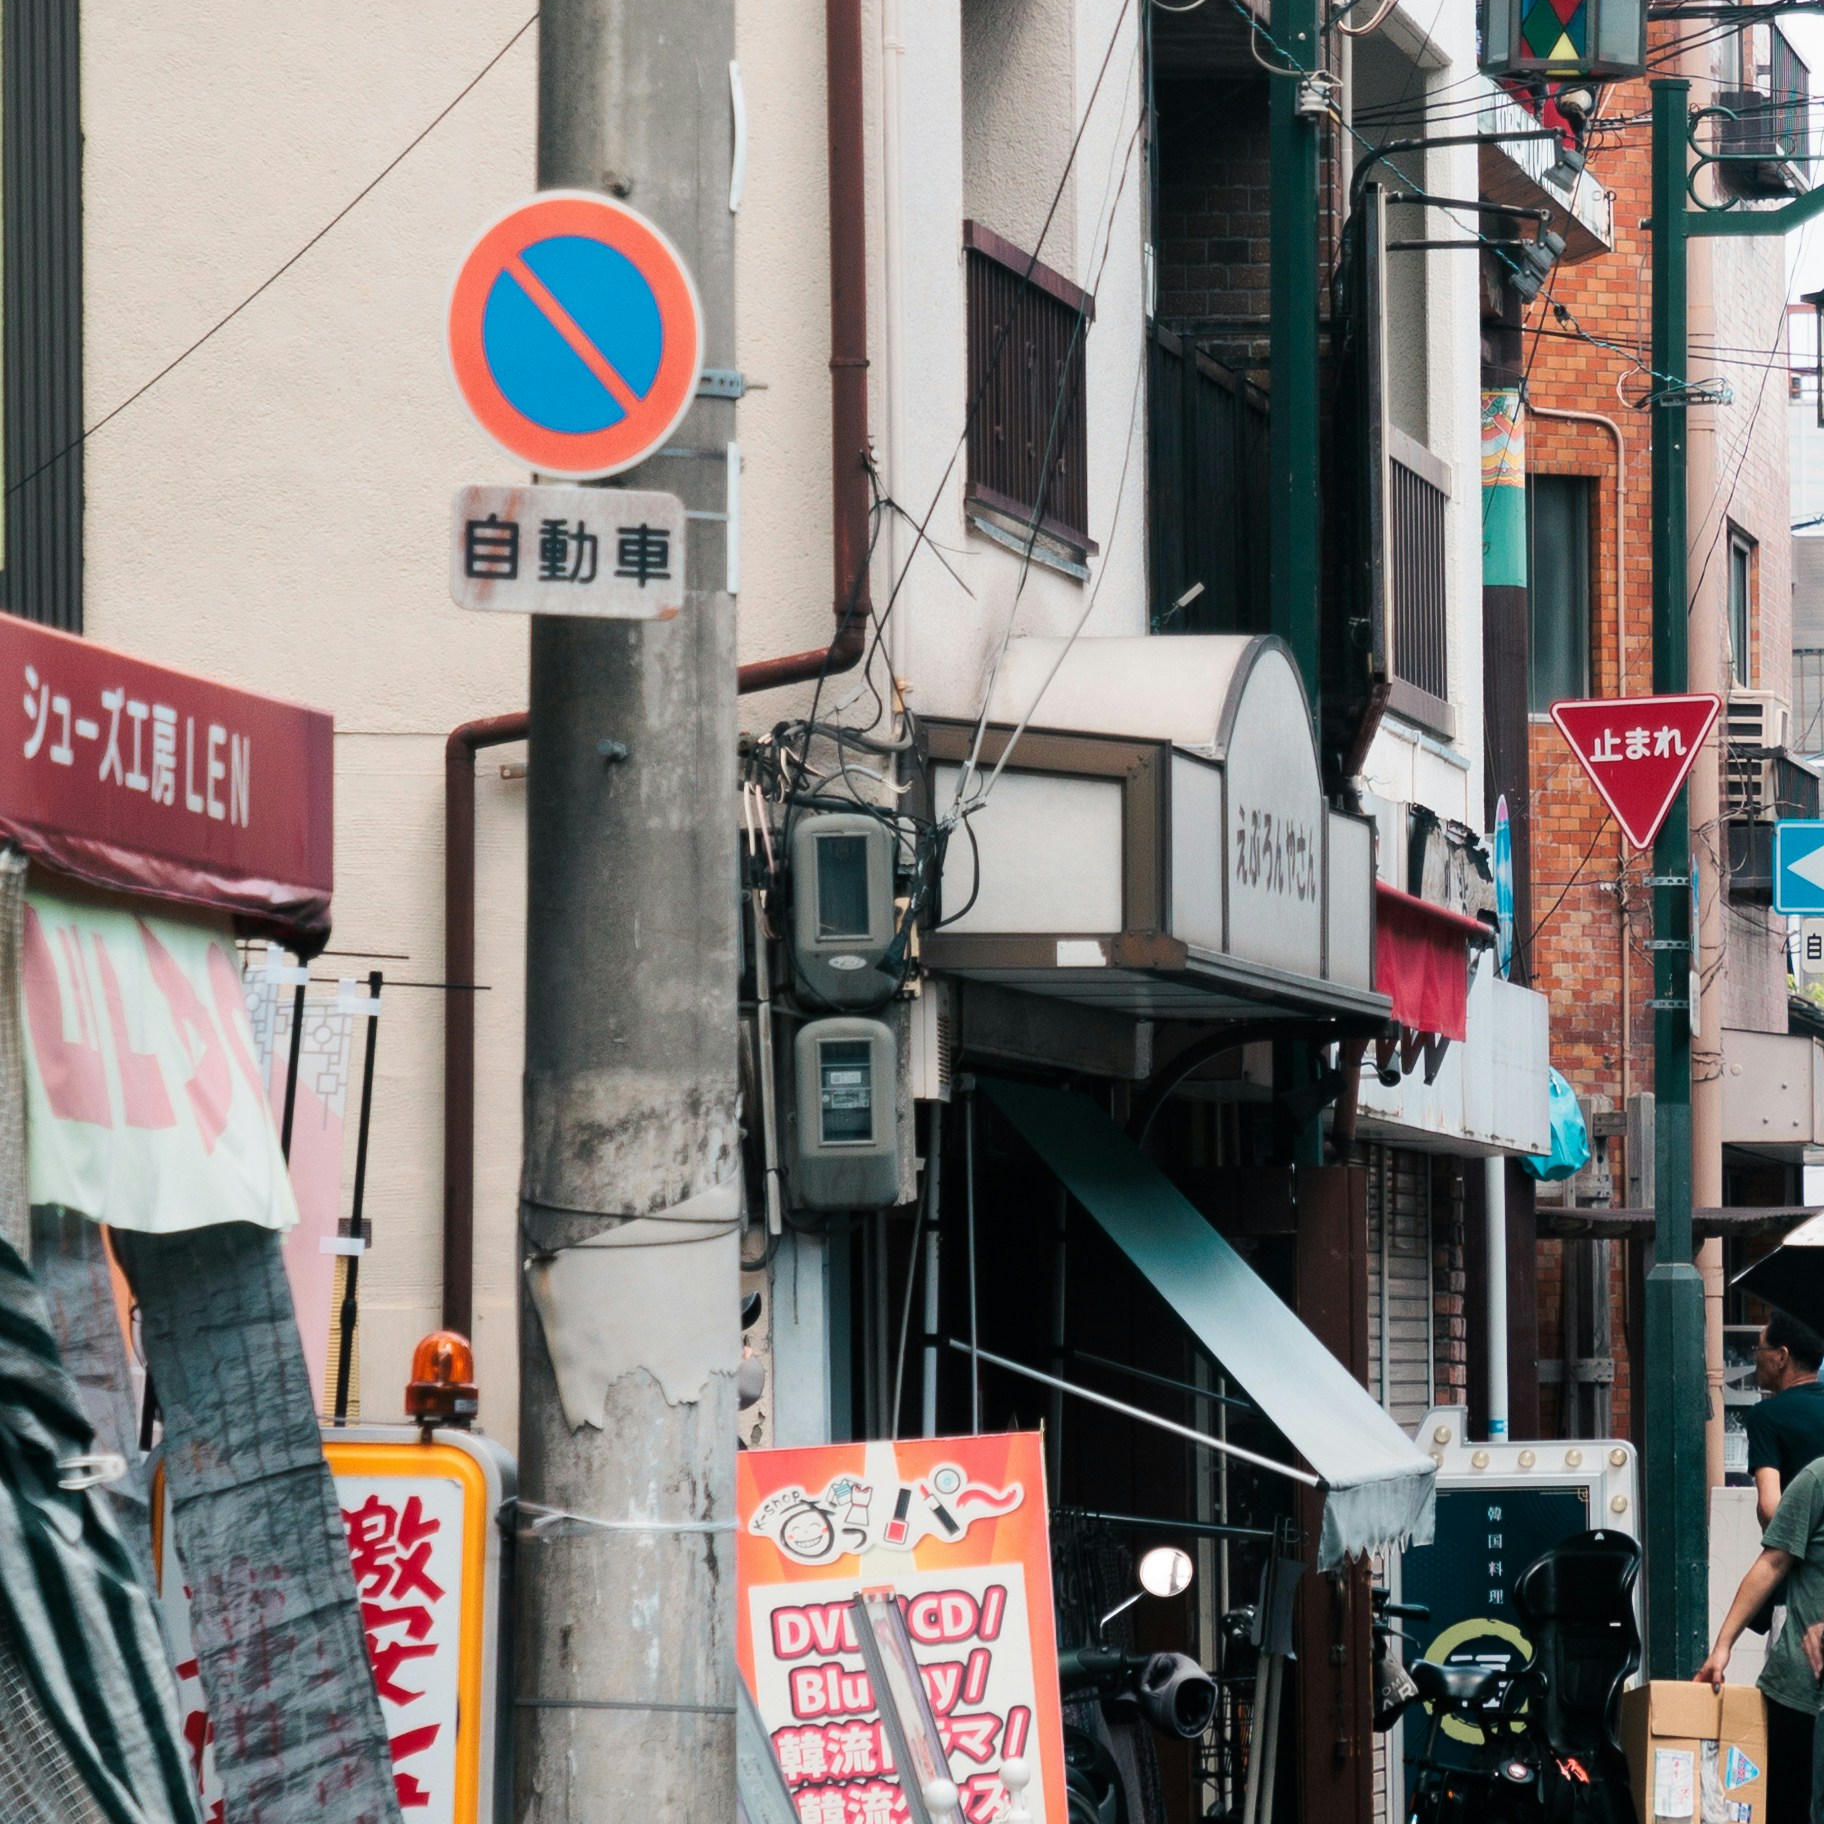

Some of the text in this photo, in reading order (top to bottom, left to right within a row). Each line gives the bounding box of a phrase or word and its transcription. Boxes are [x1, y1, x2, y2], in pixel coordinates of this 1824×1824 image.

[464, 513, 671, 588] 自動車
[23, 664, 250, 828] シューズ工房 LEN
[1590, 725, 1687, 763] 止まれ
[1487, 1506, 1503, 1604] 韓国料理
